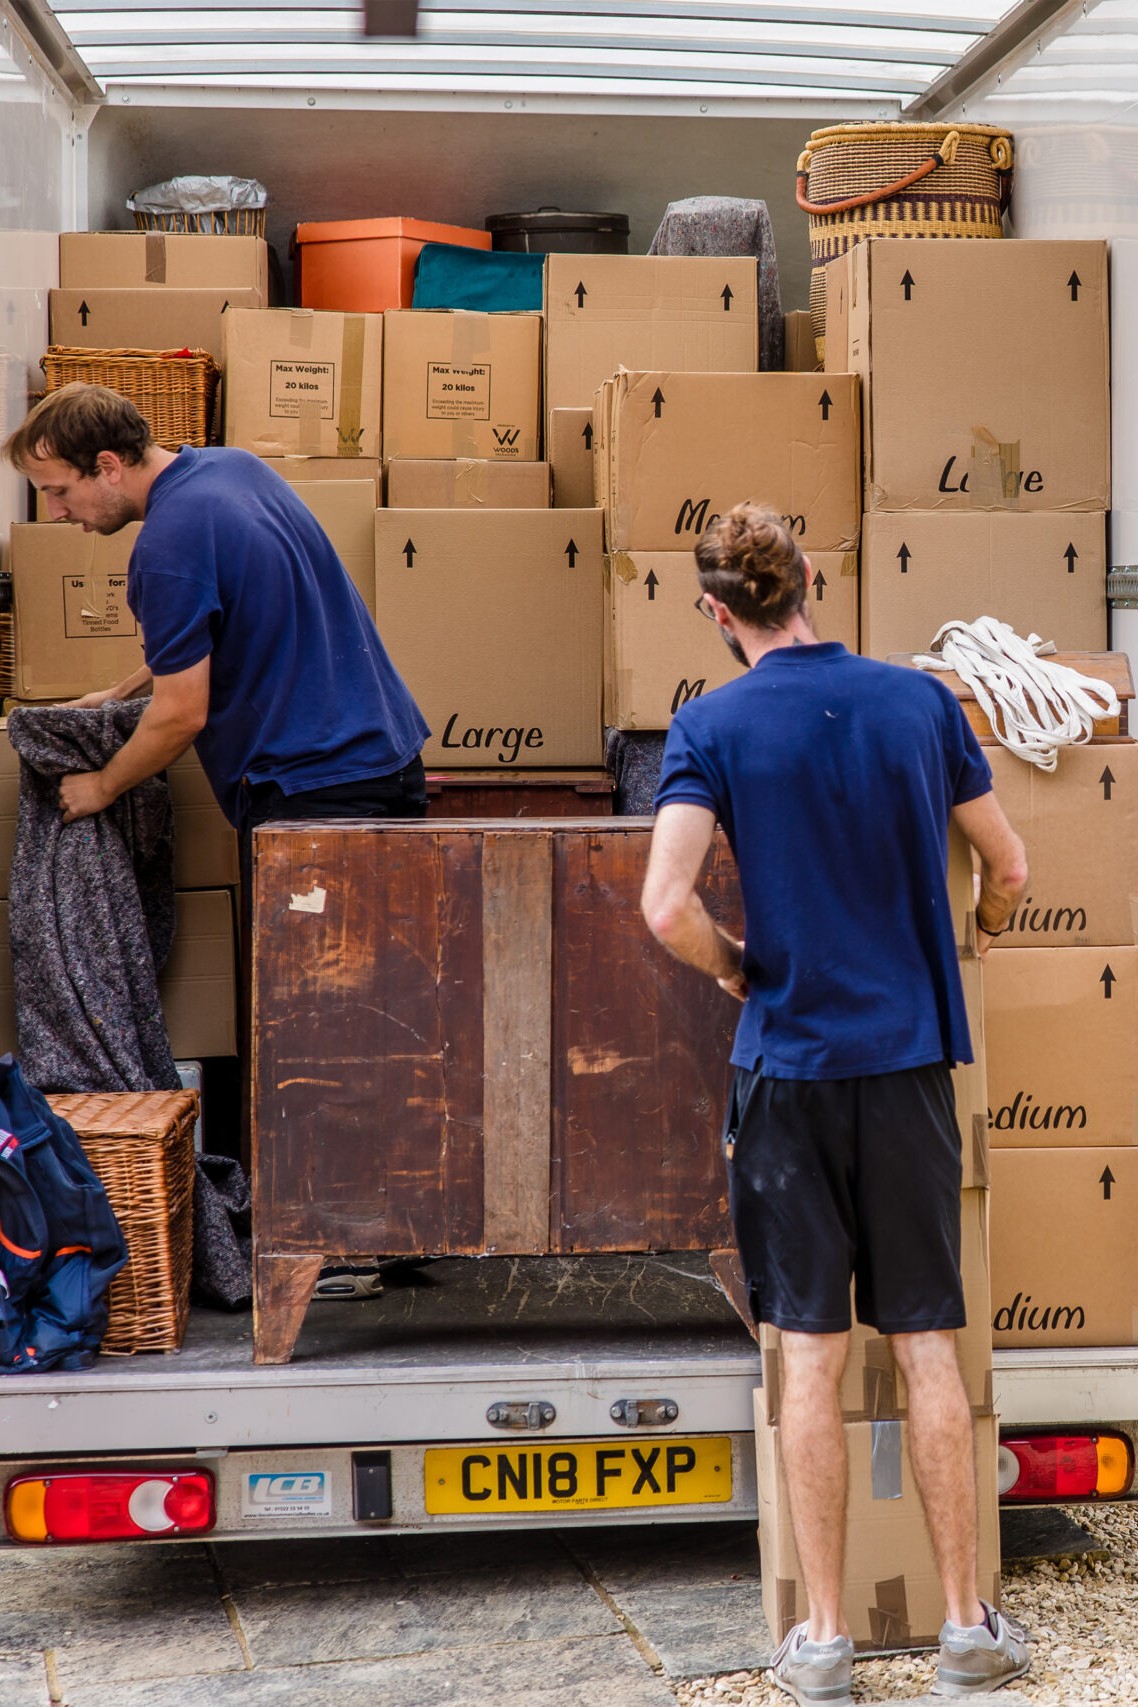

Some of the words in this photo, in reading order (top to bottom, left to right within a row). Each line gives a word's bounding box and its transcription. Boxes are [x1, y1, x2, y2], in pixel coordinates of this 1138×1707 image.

[275, 364, 293, 373] Max
[295, 365, 329, 375] Weight:
[432, 366, 450, 374] Max
[285, 381, 297, 389] 20
[298, 382, 319, 390] kilos
[442, 383, 453, 391] 20
[455, 384, 475, 392] kilos
[108, 579, 126, 588] for:
[441, 713, 544, 763] Large
[992, 1291, 1085, 1331] dium
[461, 1451, 578, 1501] CN18
[595, 1445, 697, 1497] FXP
